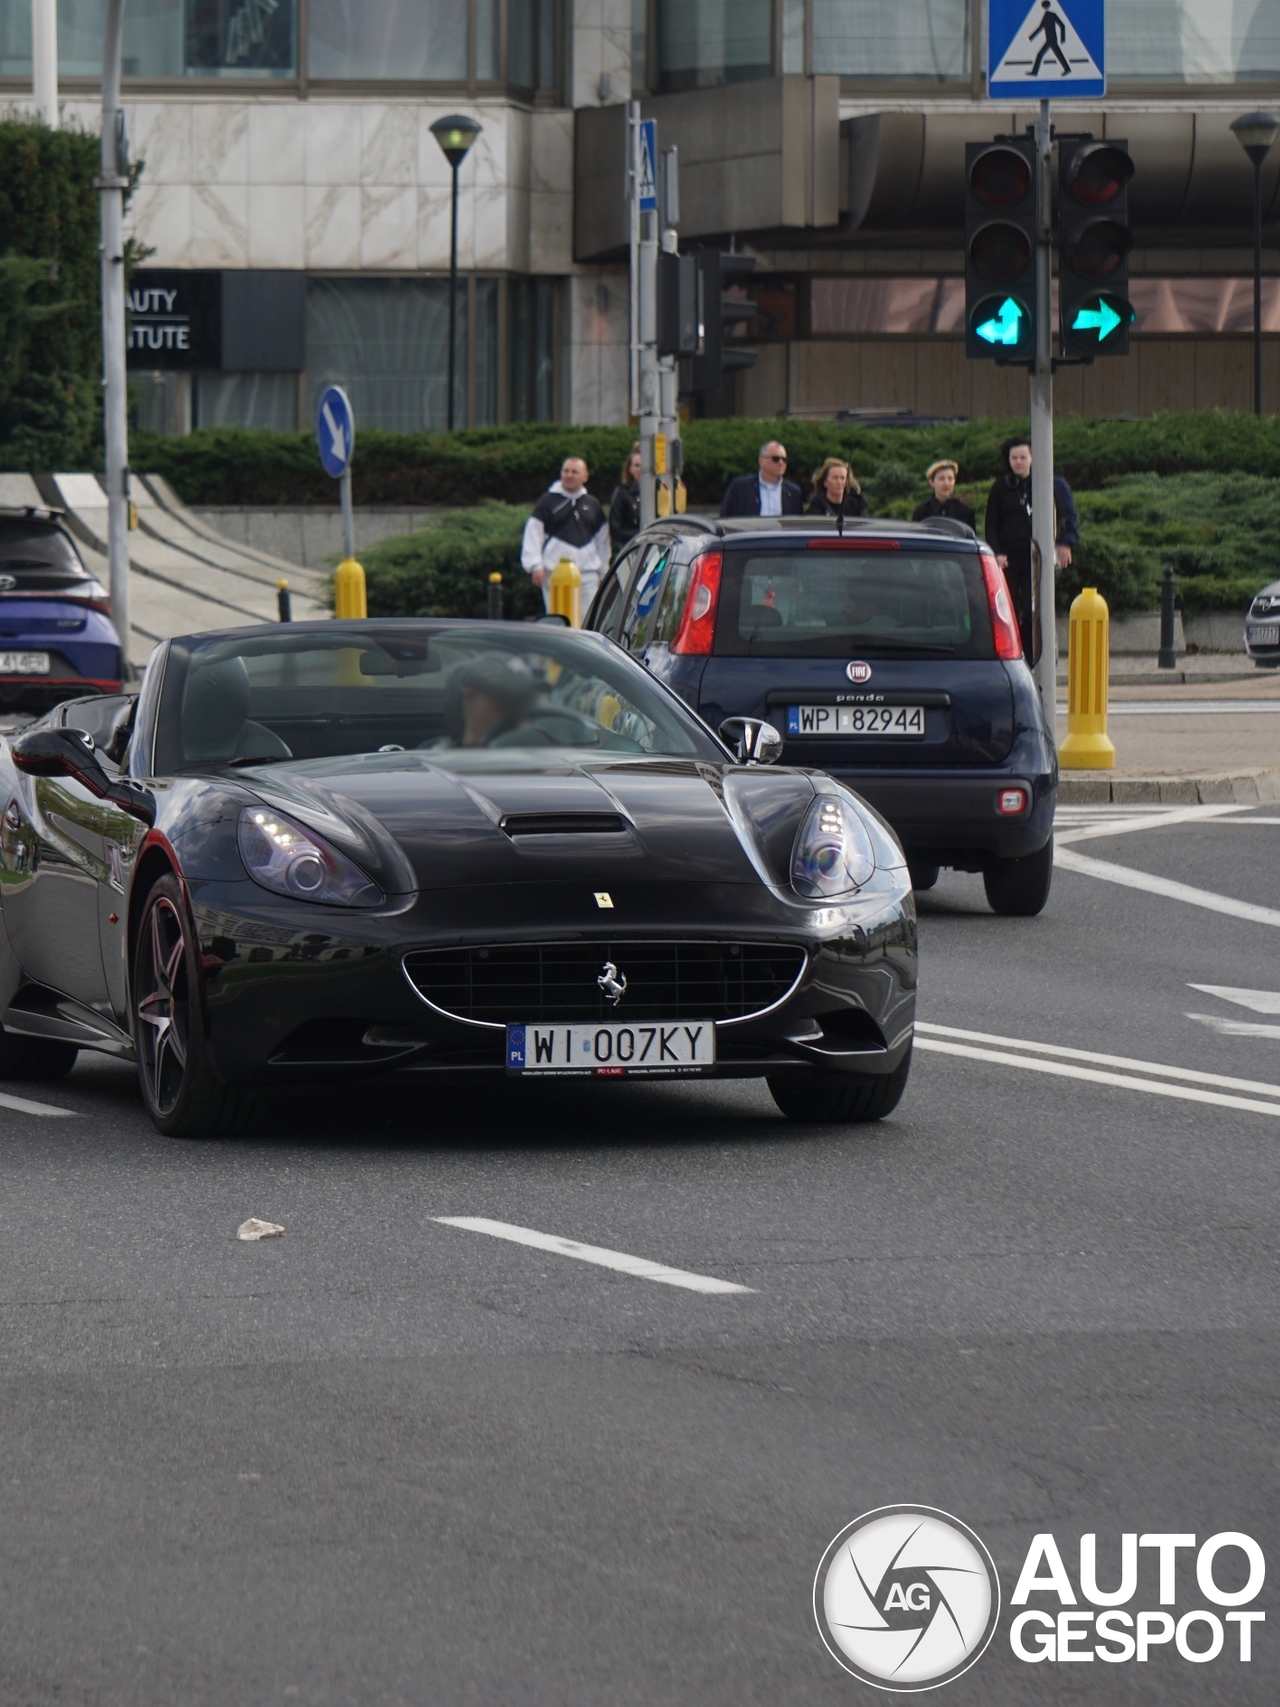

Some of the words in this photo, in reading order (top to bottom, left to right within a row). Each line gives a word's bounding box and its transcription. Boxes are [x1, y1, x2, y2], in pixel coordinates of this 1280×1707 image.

[851, 666, 866, 678] FIAT
[836, 693, 884, 702] panda
[801, 709, 839, 731] WPI
[852, 708, 921, 731] 82944
[789, 722, 799, 730] PL
[534, 1029, 572, 1063] WI
[594, 1026, 703, 1062] 007KY
[511, 1051, 524, 1061] PL
